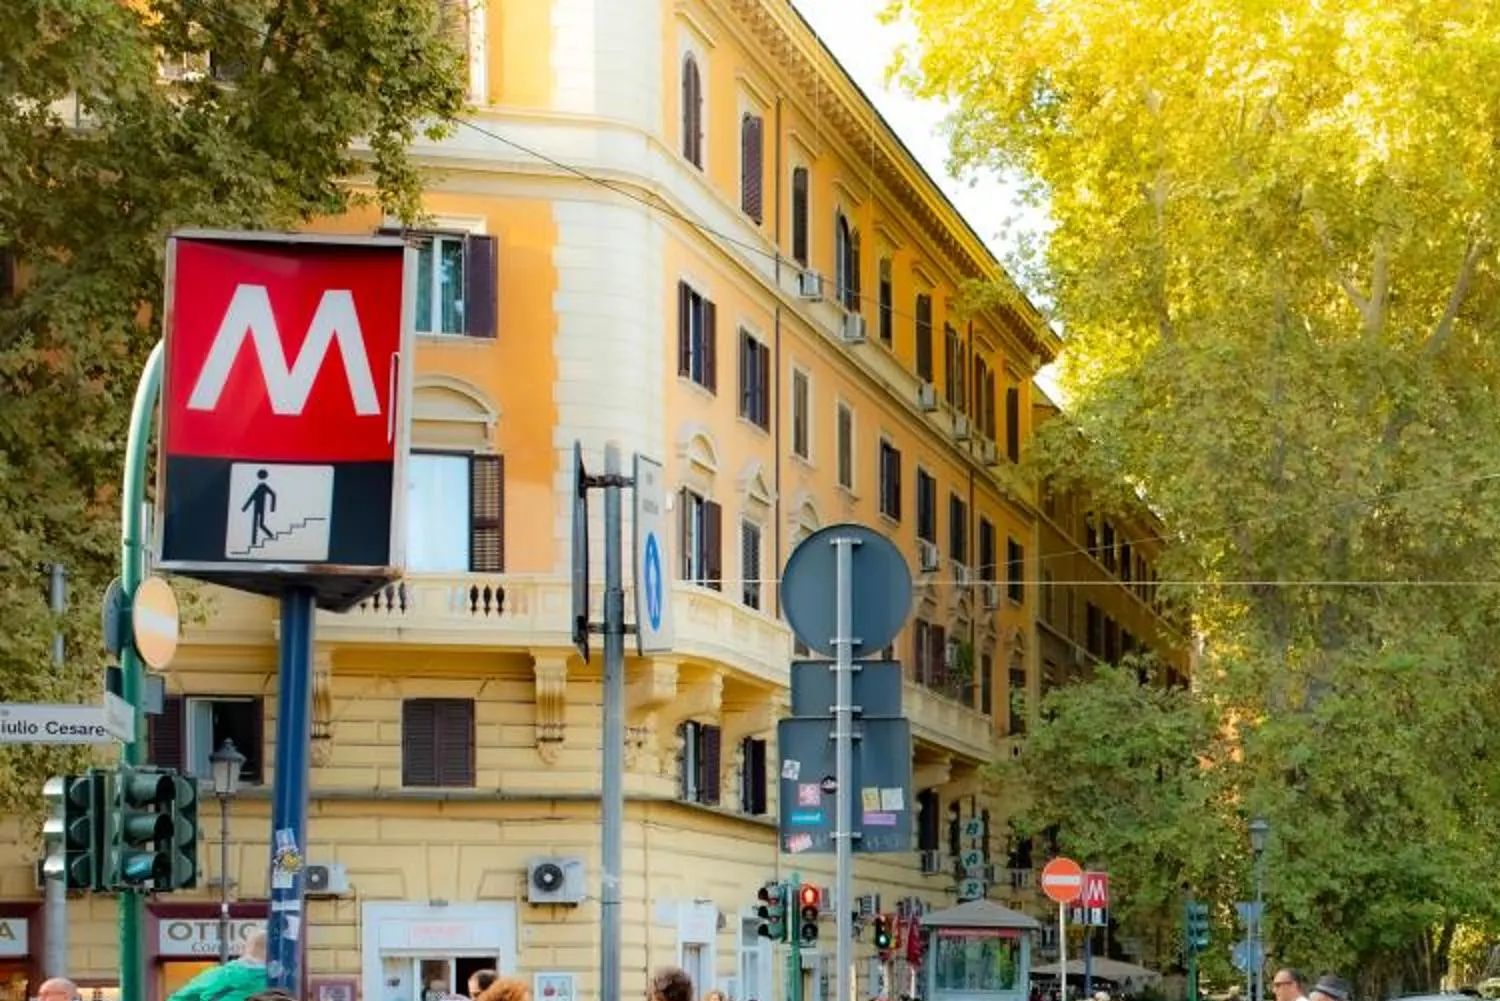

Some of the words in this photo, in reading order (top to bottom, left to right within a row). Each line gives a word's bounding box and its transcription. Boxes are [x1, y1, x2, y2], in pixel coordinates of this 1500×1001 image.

[186, 283, 381, 416] M
[45, 721, 105, 737] Cesare
[1087, 879, 1105, 901] M
